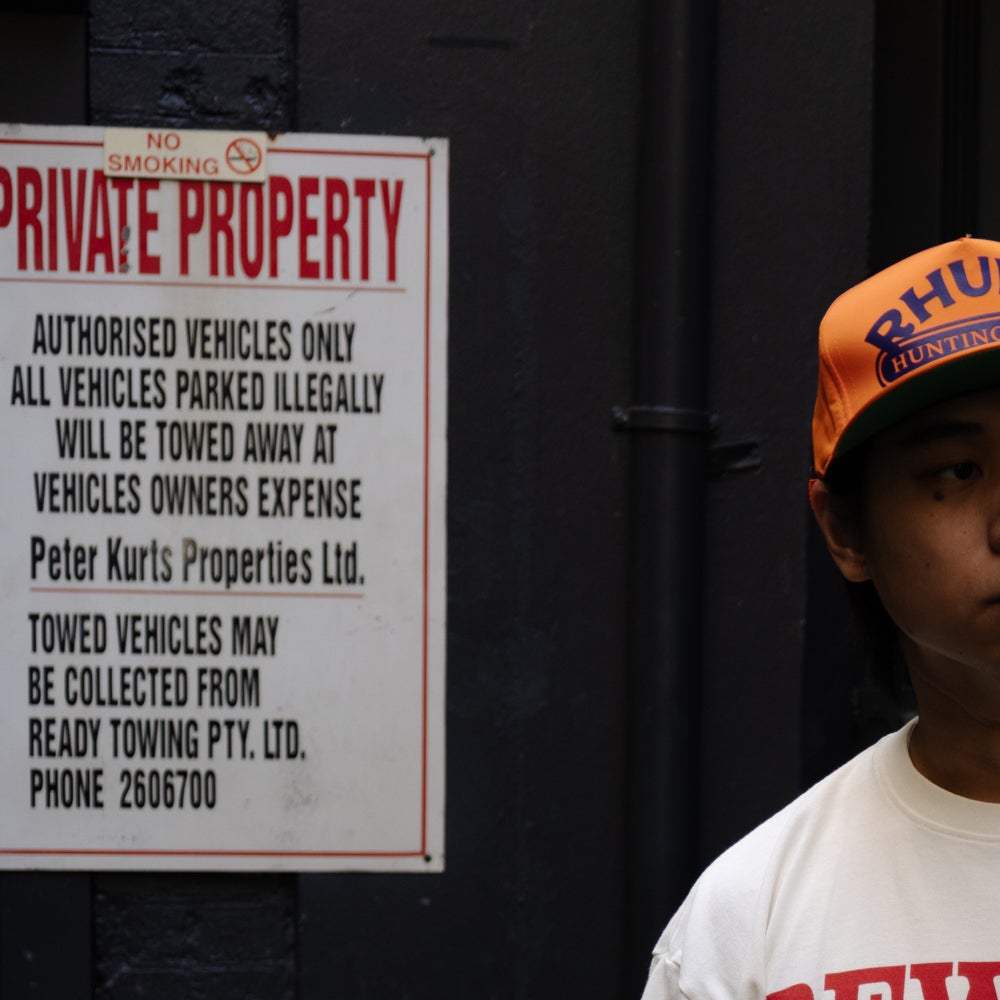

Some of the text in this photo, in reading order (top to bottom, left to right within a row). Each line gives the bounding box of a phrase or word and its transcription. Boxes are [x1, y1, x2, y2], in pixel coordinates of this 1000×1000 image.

[147, 133, 181, 151] NO
[108, 154, 220, 176] SMOKING
[178, 174, 404, 282] PROPERTY
[32, 314, 356, 362] AUTHORISED VEHICLES ONLY
[10, 365, 385, 414] ALL VEHICLES PARKED ILLEGALLY
[56, 418, 338, 464] WILL BE TOWED AWAY AT
[34, 472, 362, 519] VEHICLES OWNERS EXPENSE
[30, 536, 365, 589] Peter Kurts Properties Ltd.
[28, 613, 279, 656] TOWED VEHICLES MAY
[28, 666, 260, 707] BE COLLECTED FROM
[28, 718, 306, 760] READY TOWING PTY. LTD.
[30, 769, 217, 809] PHONE 2606700
